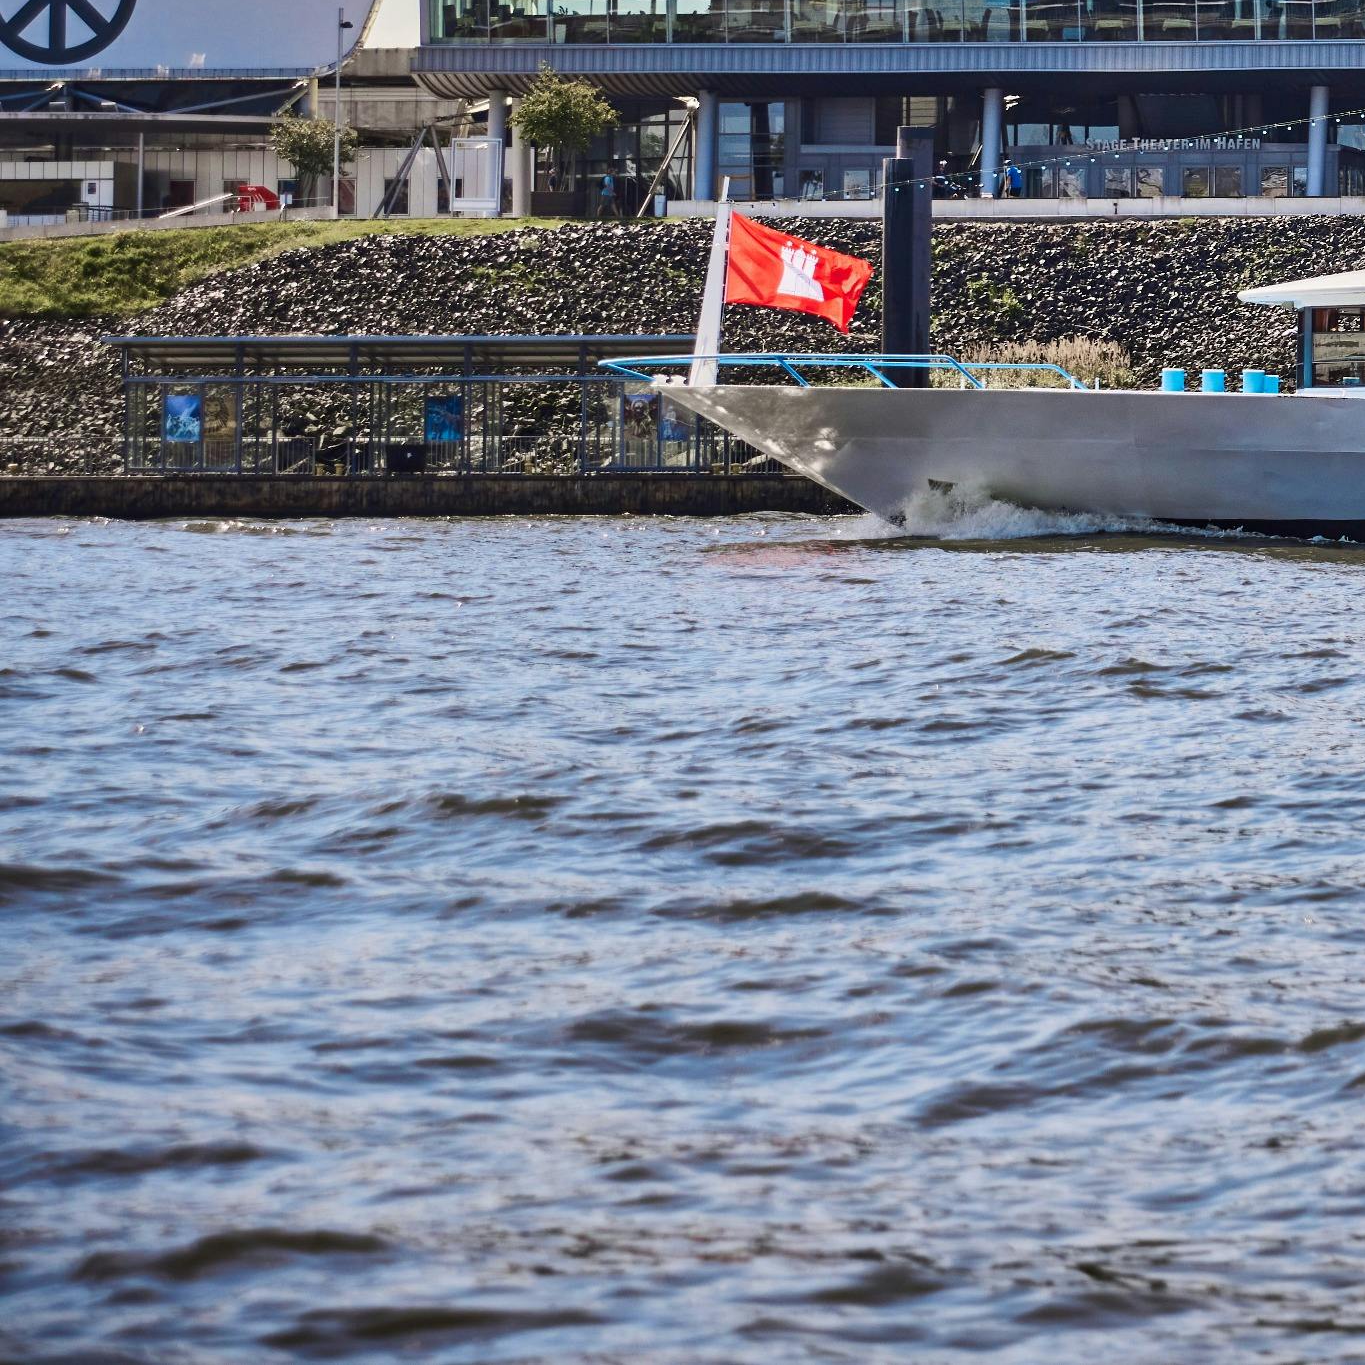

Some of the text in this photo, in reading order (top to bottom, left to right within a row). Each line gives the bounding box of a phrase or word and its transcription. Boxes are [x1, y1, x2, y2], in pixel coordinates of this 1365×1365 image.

[1085, 136, 1261, 151] STAGE THEATER IM HAFEN
